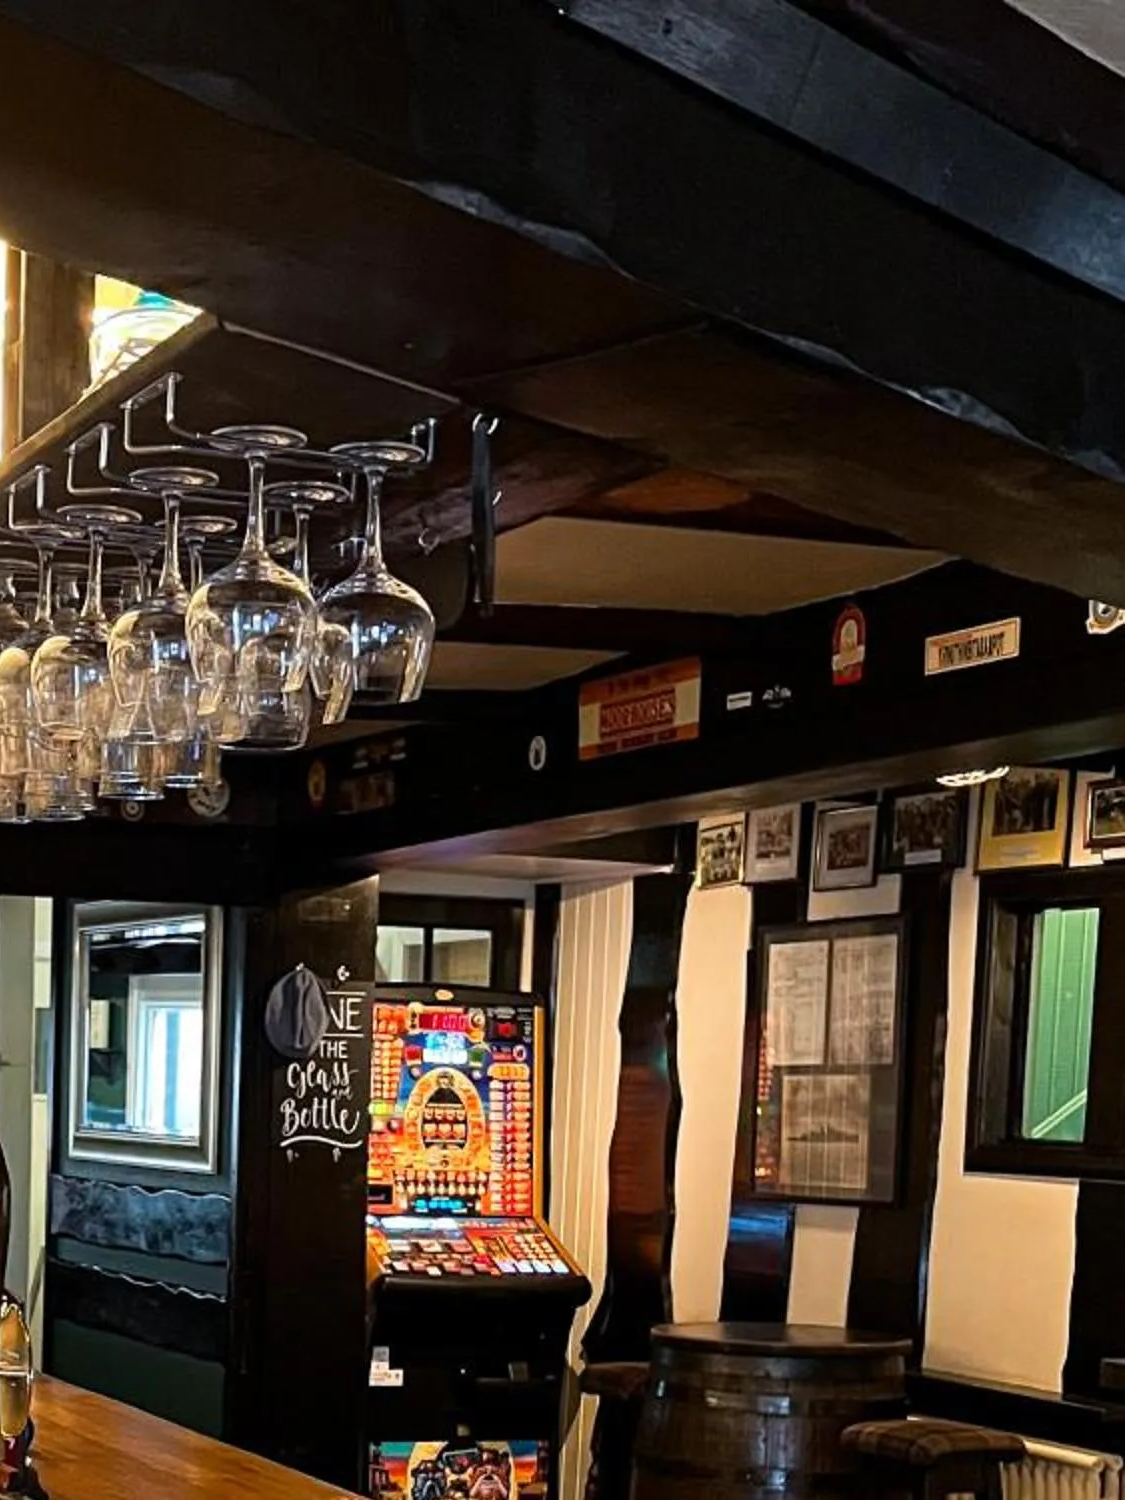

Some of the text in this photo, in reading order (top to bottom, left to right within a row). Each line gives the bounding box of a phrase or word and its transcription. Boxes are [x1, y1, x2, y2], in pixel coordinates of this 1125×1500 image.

[319, 1040, 349, 1059] THE
[287, 1060, 359, 1098] Glass
[280, 1098, 360, 1136] Bottle
